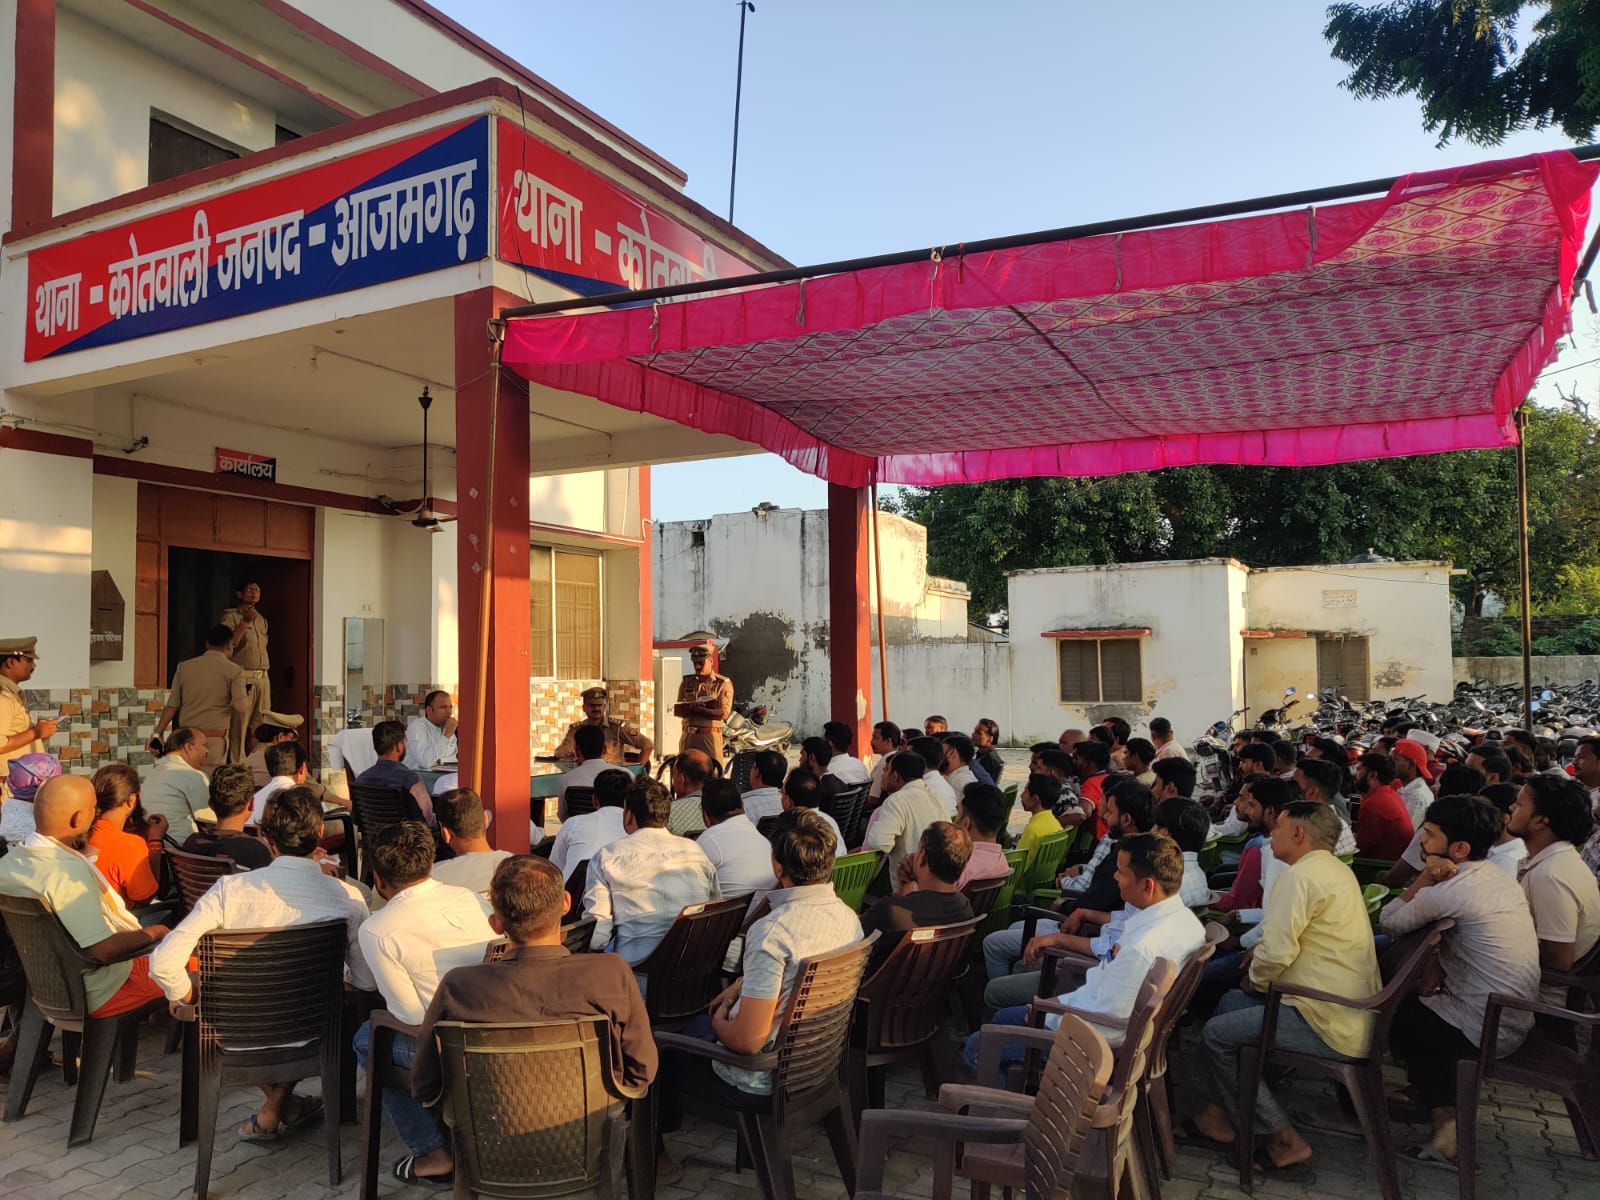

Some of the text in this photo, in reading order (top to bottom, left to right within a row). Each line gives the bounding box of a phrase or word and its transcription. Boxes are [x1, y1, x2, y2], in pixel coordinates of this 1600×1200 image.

[35, 272, 82, 337] थाना
[108, 209, 211, 320] कोतवाली
[216, 209, 304, 290] जनपद
[331, 158, 478, 261] आजमगढ़
[513, 168, 583, 265] थाना
[219, 455, 274, 478] कार्यालय
